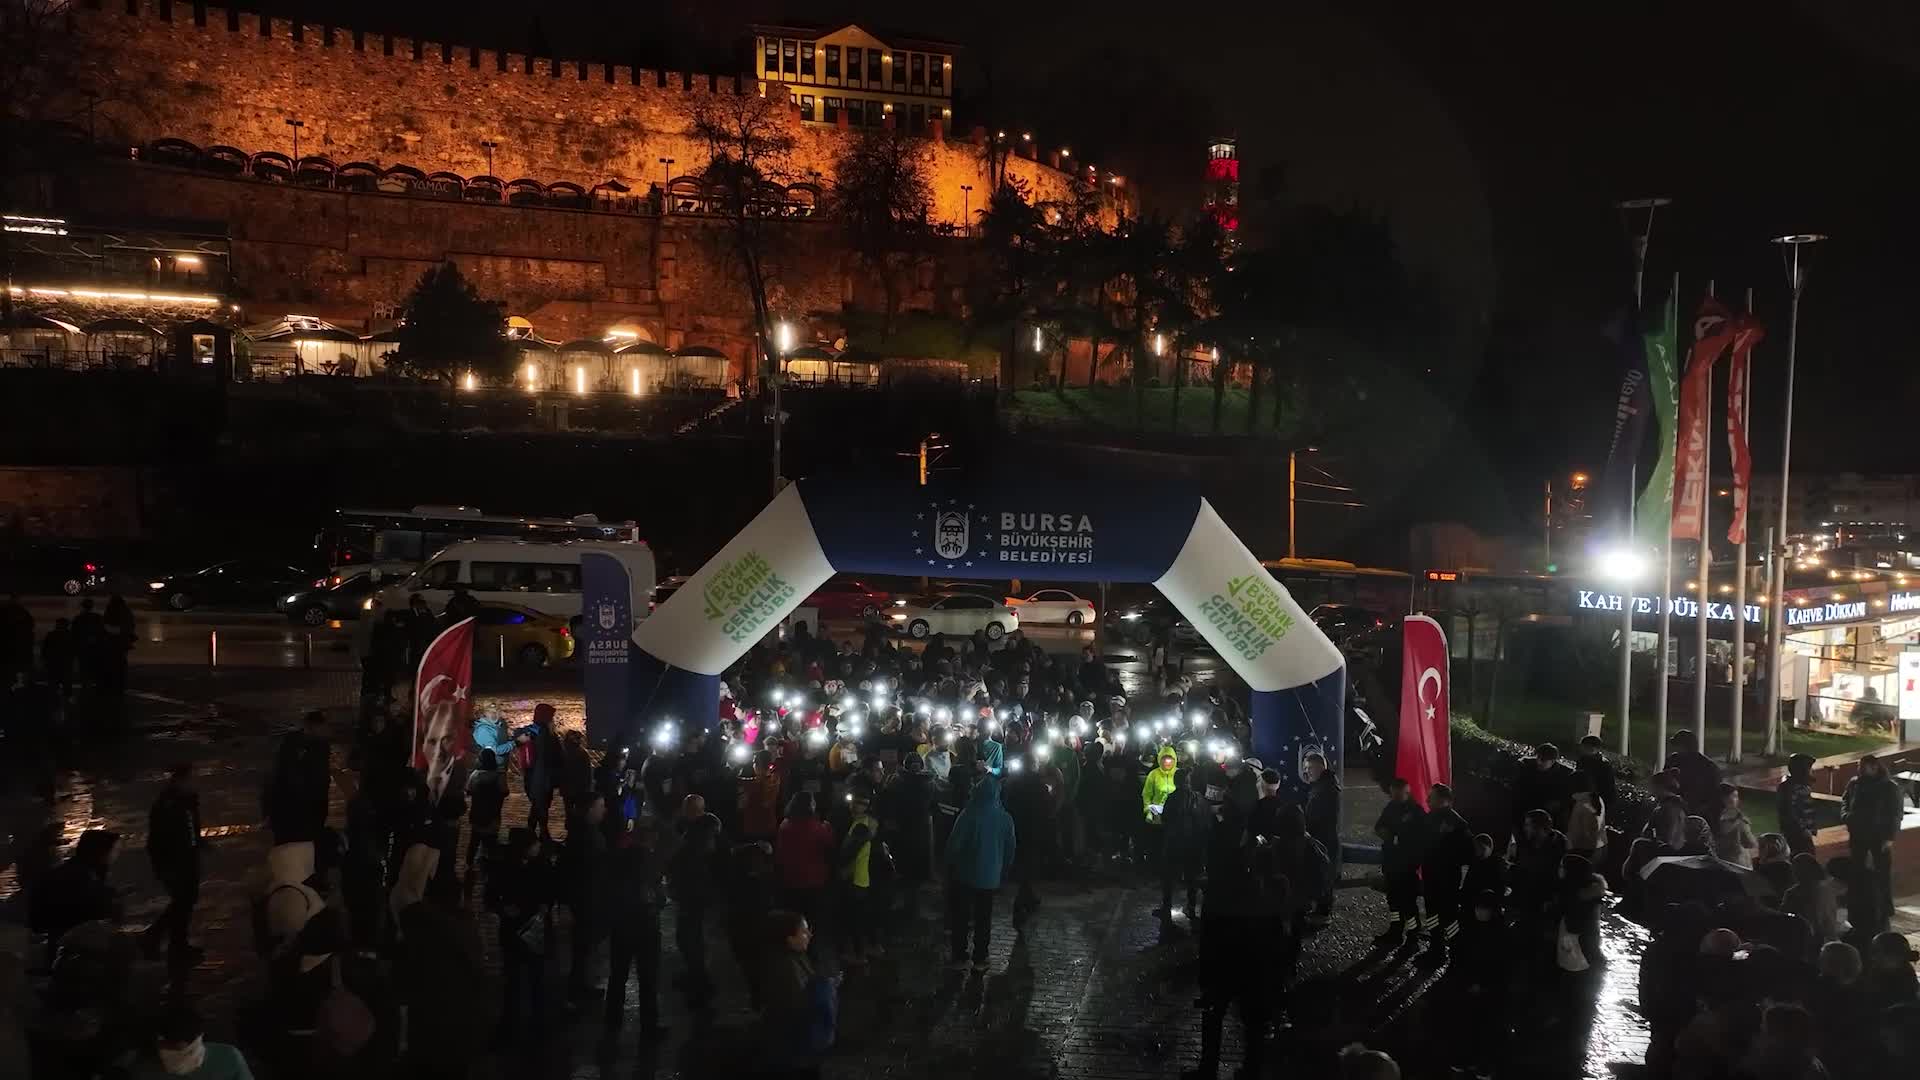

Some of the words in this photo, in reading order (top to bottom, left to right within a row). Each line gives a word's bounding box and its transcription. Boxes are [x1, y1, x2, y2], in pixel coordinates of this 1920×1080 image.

[1001, 512, 1093, 532] BURSA
[1000, 549, 1092, 563] BELEDİYESİ
[1788, 608, 1823, 625] KAHVE
